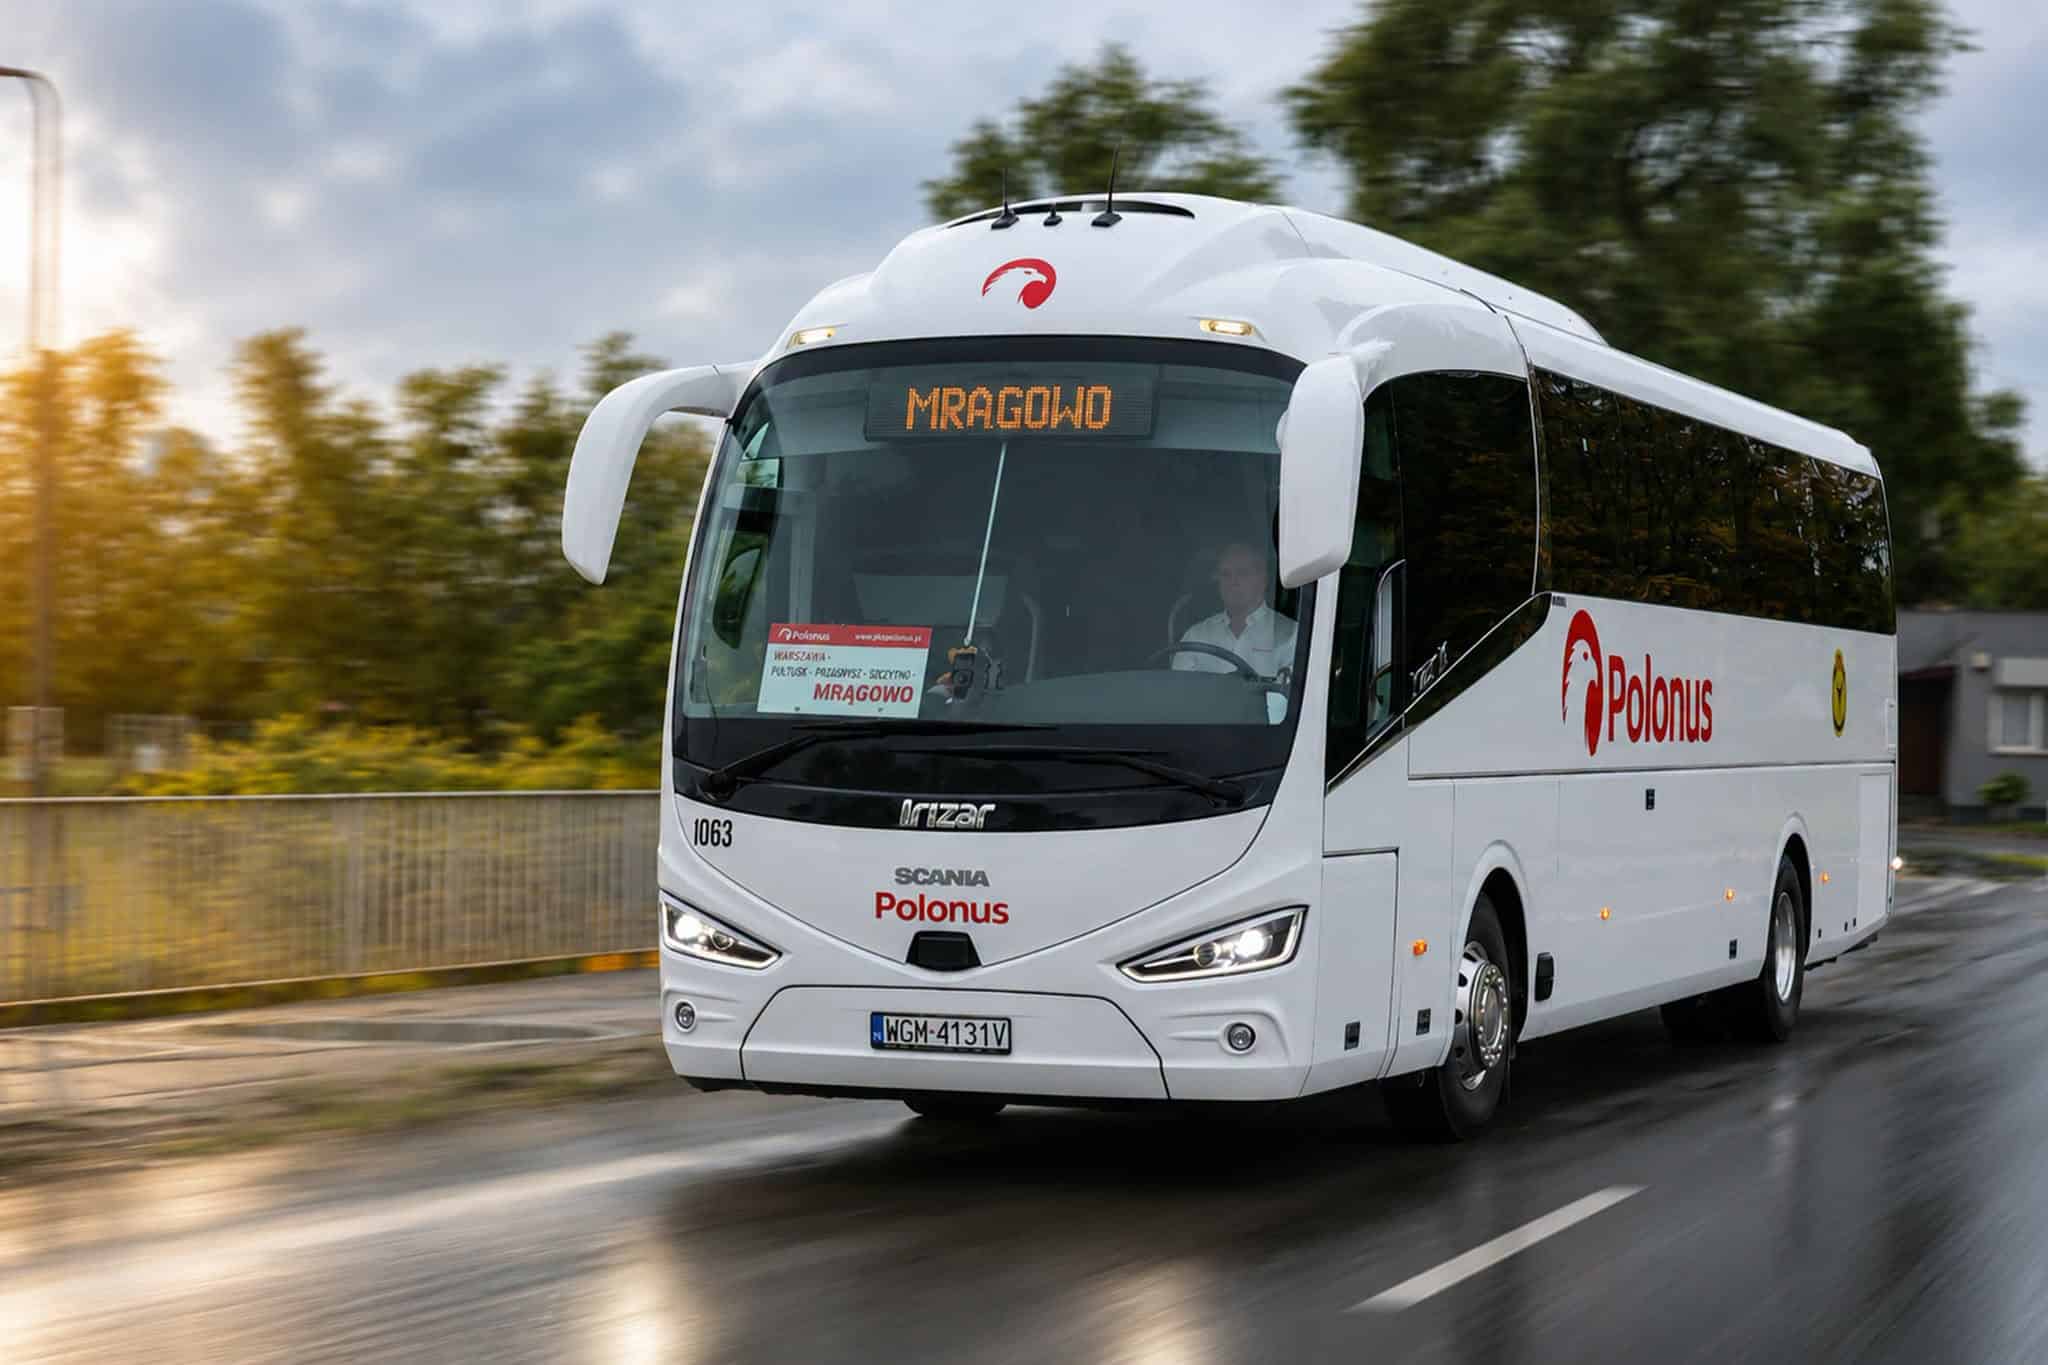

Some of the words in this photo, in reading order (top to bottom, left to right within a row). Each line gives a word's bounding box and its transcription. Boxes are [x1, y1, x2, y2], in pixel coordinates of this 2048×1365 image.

[792, 629, 831, 642] Polonus
[813, 683, 914, 706] MRĄGOWO
[1608, 653, 1713, 744] Polonus
[899, 798, 996, 830] Irizar
[694, 818, 733, 848] 1063
[895, 867, 990, 887] SCANIA
[875, 891, 1009, 924] Polonus
